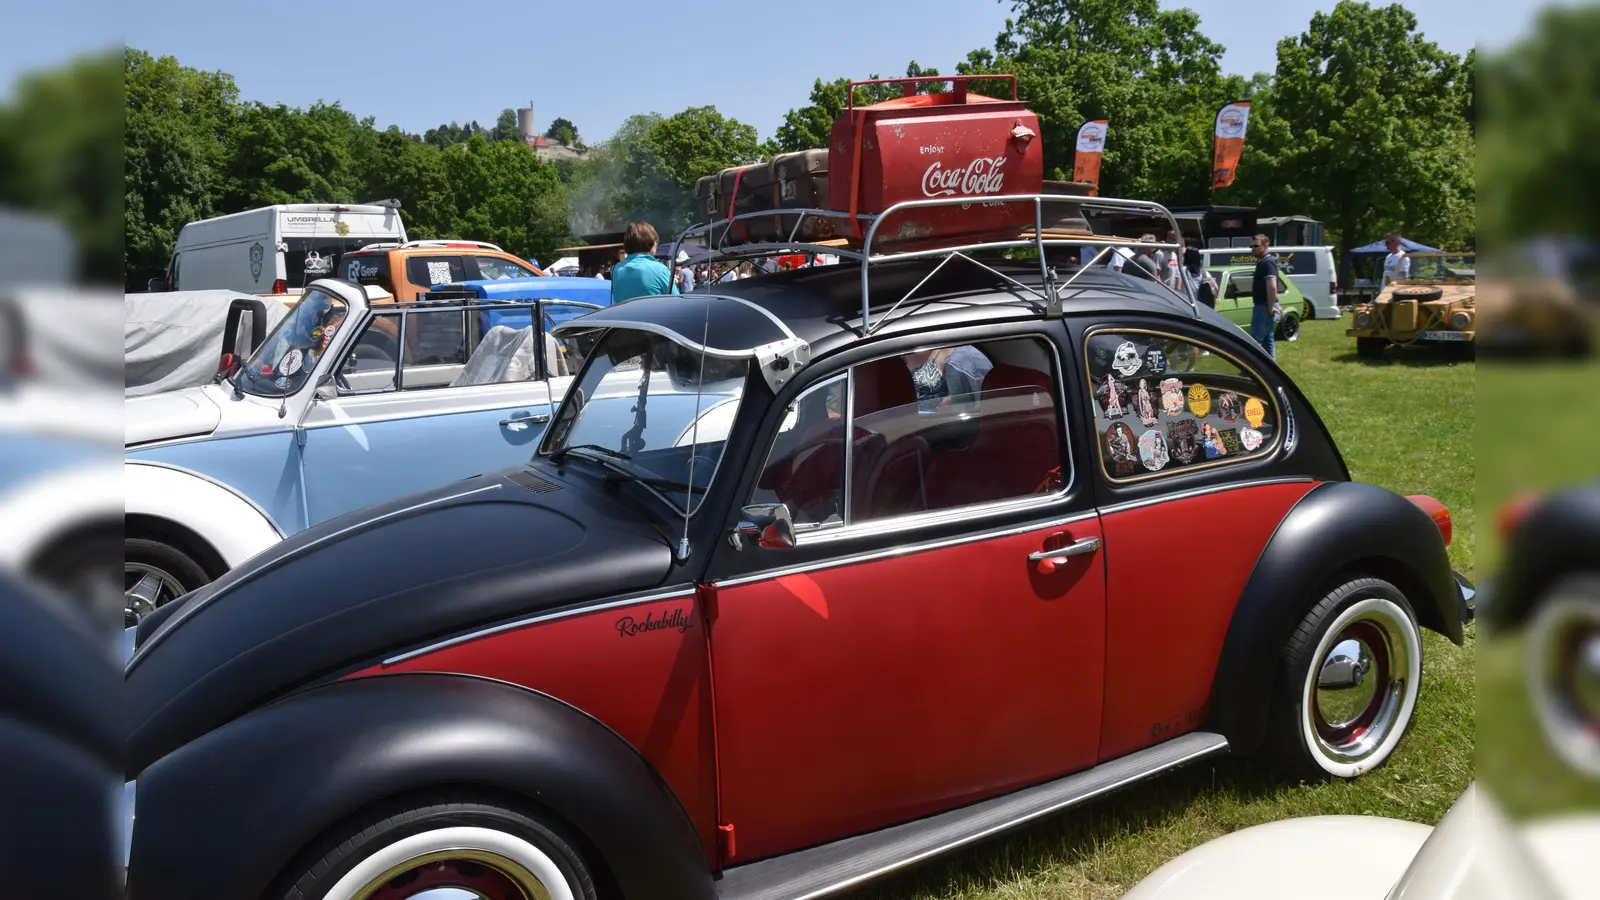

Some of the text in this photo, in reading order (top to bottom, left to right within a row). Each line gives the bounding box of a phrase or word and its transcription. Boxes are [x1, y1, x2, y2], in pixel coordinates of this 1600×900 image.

[921, 157, 1007, 197] Coca-Cola
[1246, 408, 1262, 417] SHELL
[615, 607, 694, 638] Rockabilly
